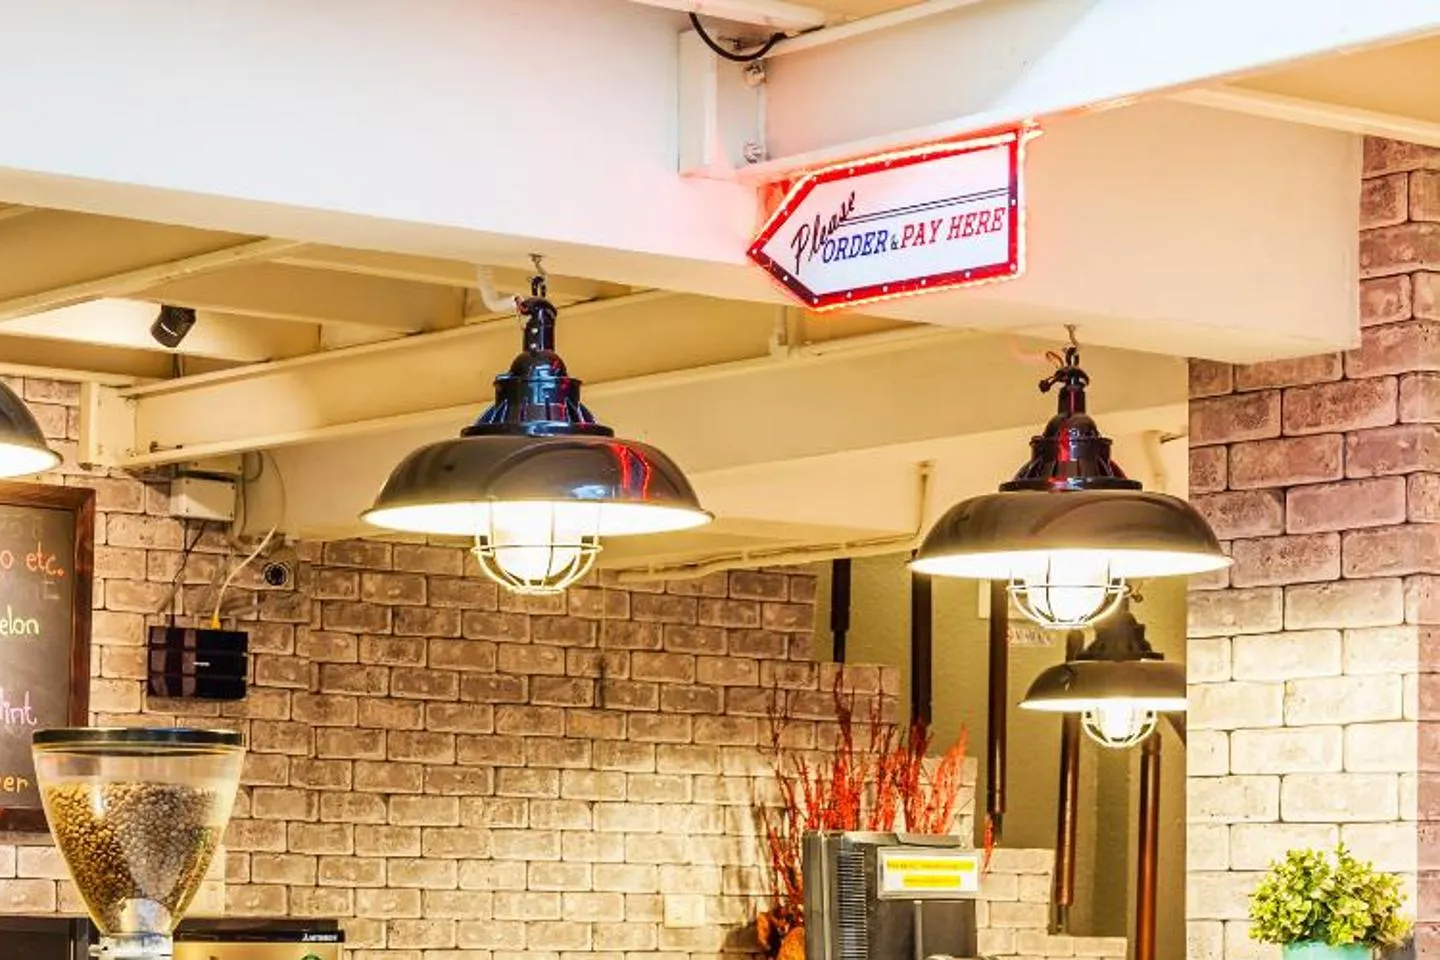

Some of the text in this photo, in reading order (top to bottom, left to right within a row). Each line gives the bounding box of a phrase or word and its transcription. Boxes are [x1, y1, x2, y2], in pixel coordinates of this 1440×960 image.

[790, 190, 855, 275] Please
[822, 229, 889, 264] ORDER
[900, 218, 944, 249] PAY
[946, 207, 1007, 241] HERE
